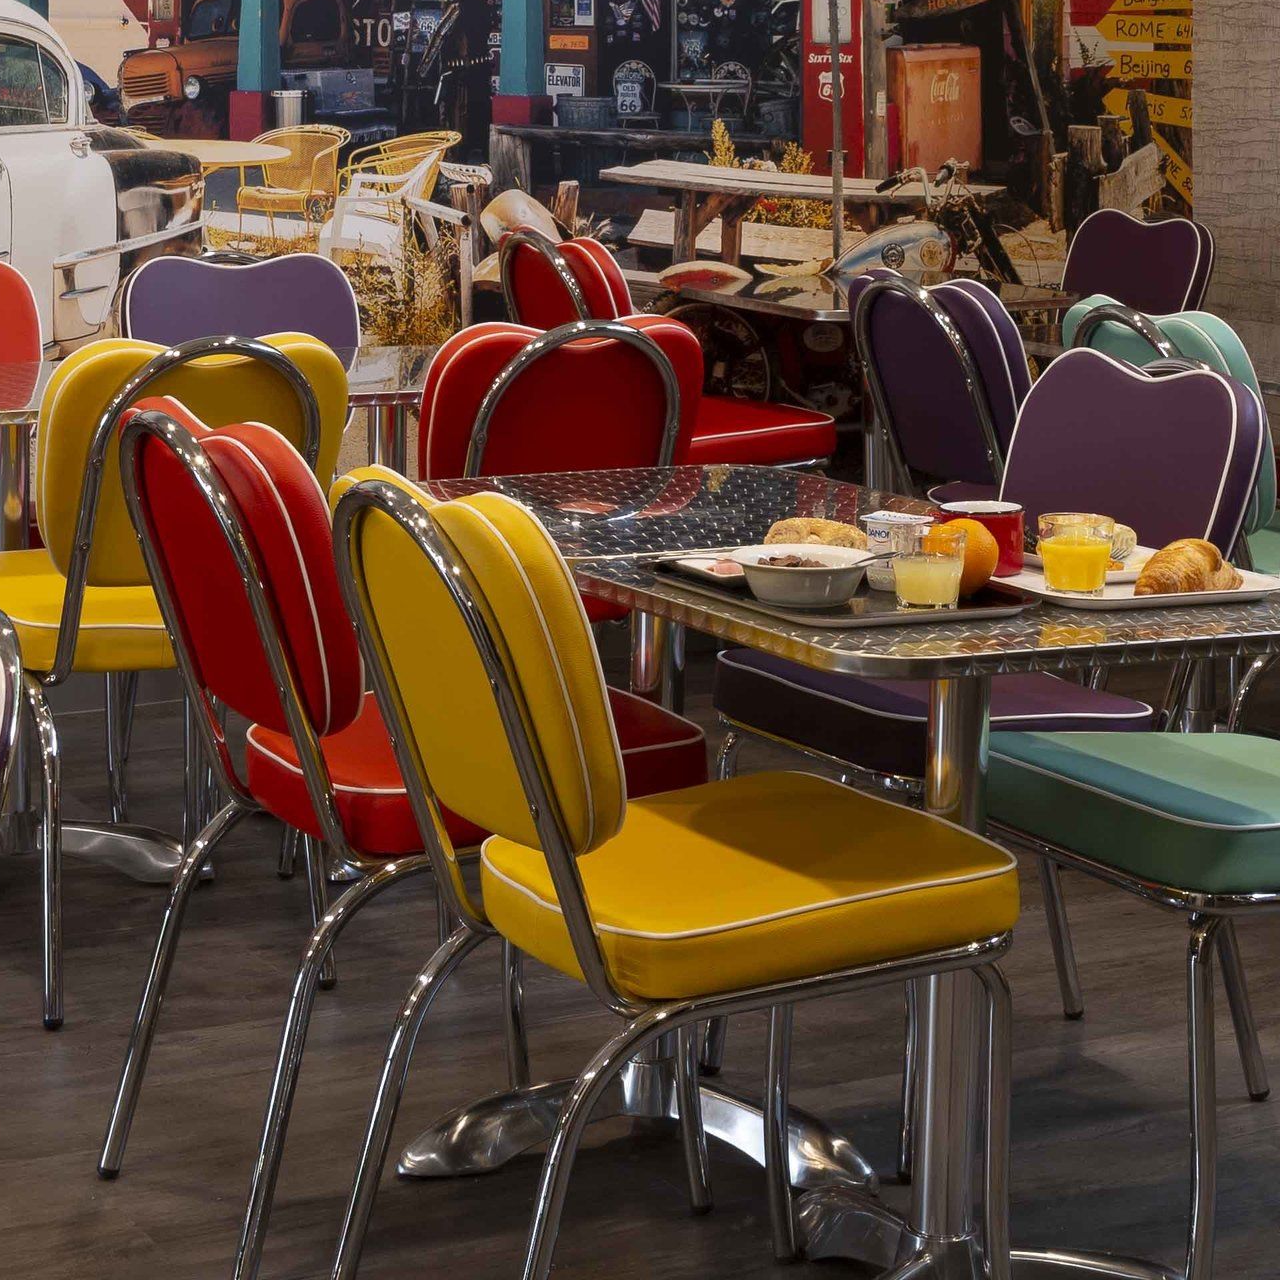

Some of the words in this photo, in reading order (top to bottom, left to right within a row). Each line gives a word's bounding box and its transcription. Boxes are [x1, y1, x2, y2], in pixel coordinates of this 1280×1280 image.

[1116, 19, 1167, 39] ROME
[1120, 54, 1171, 79] Beijing
[548, 74, 581, 87] ELEVATOR
[620, 99, 637, 111] 66
